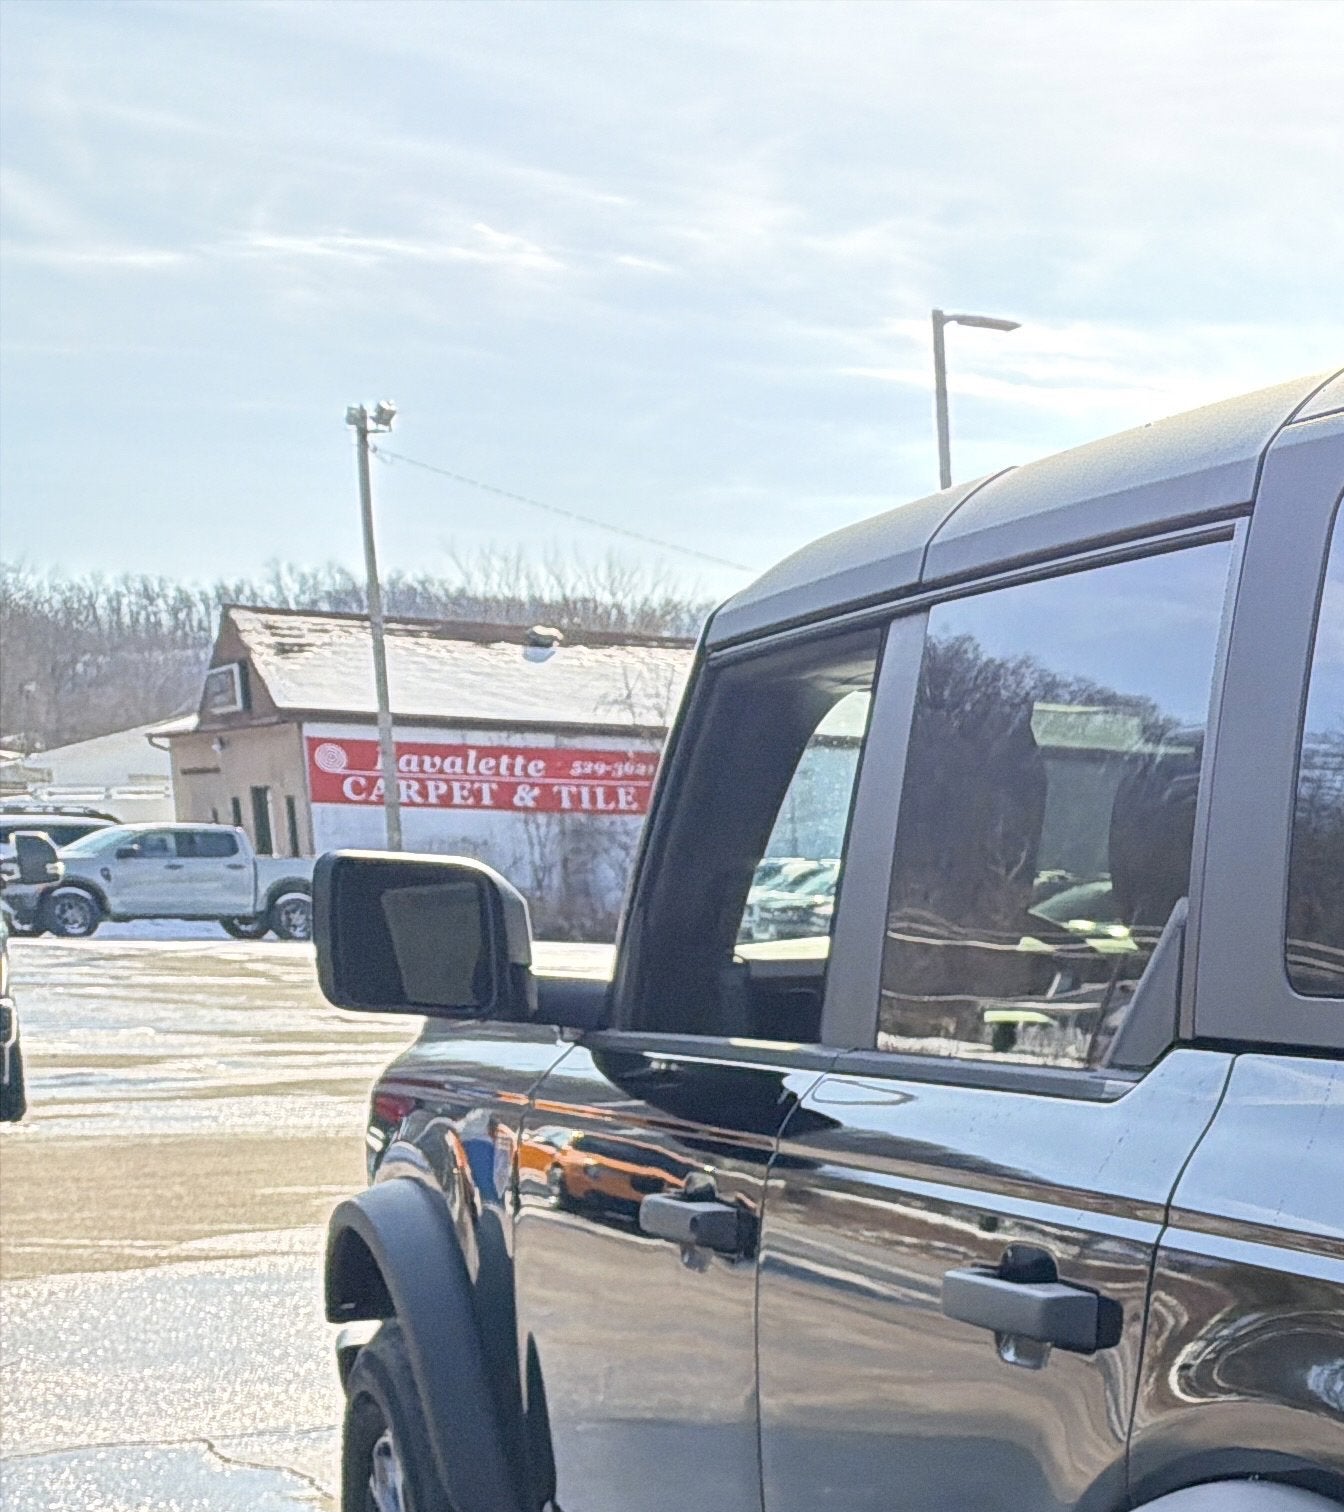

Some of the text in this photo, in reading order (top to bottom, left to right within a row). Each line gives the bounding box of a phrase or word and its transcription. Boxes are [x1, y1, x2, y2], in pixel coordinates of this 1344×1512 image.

[342, 776, 639, 811] CARPET & TILE
